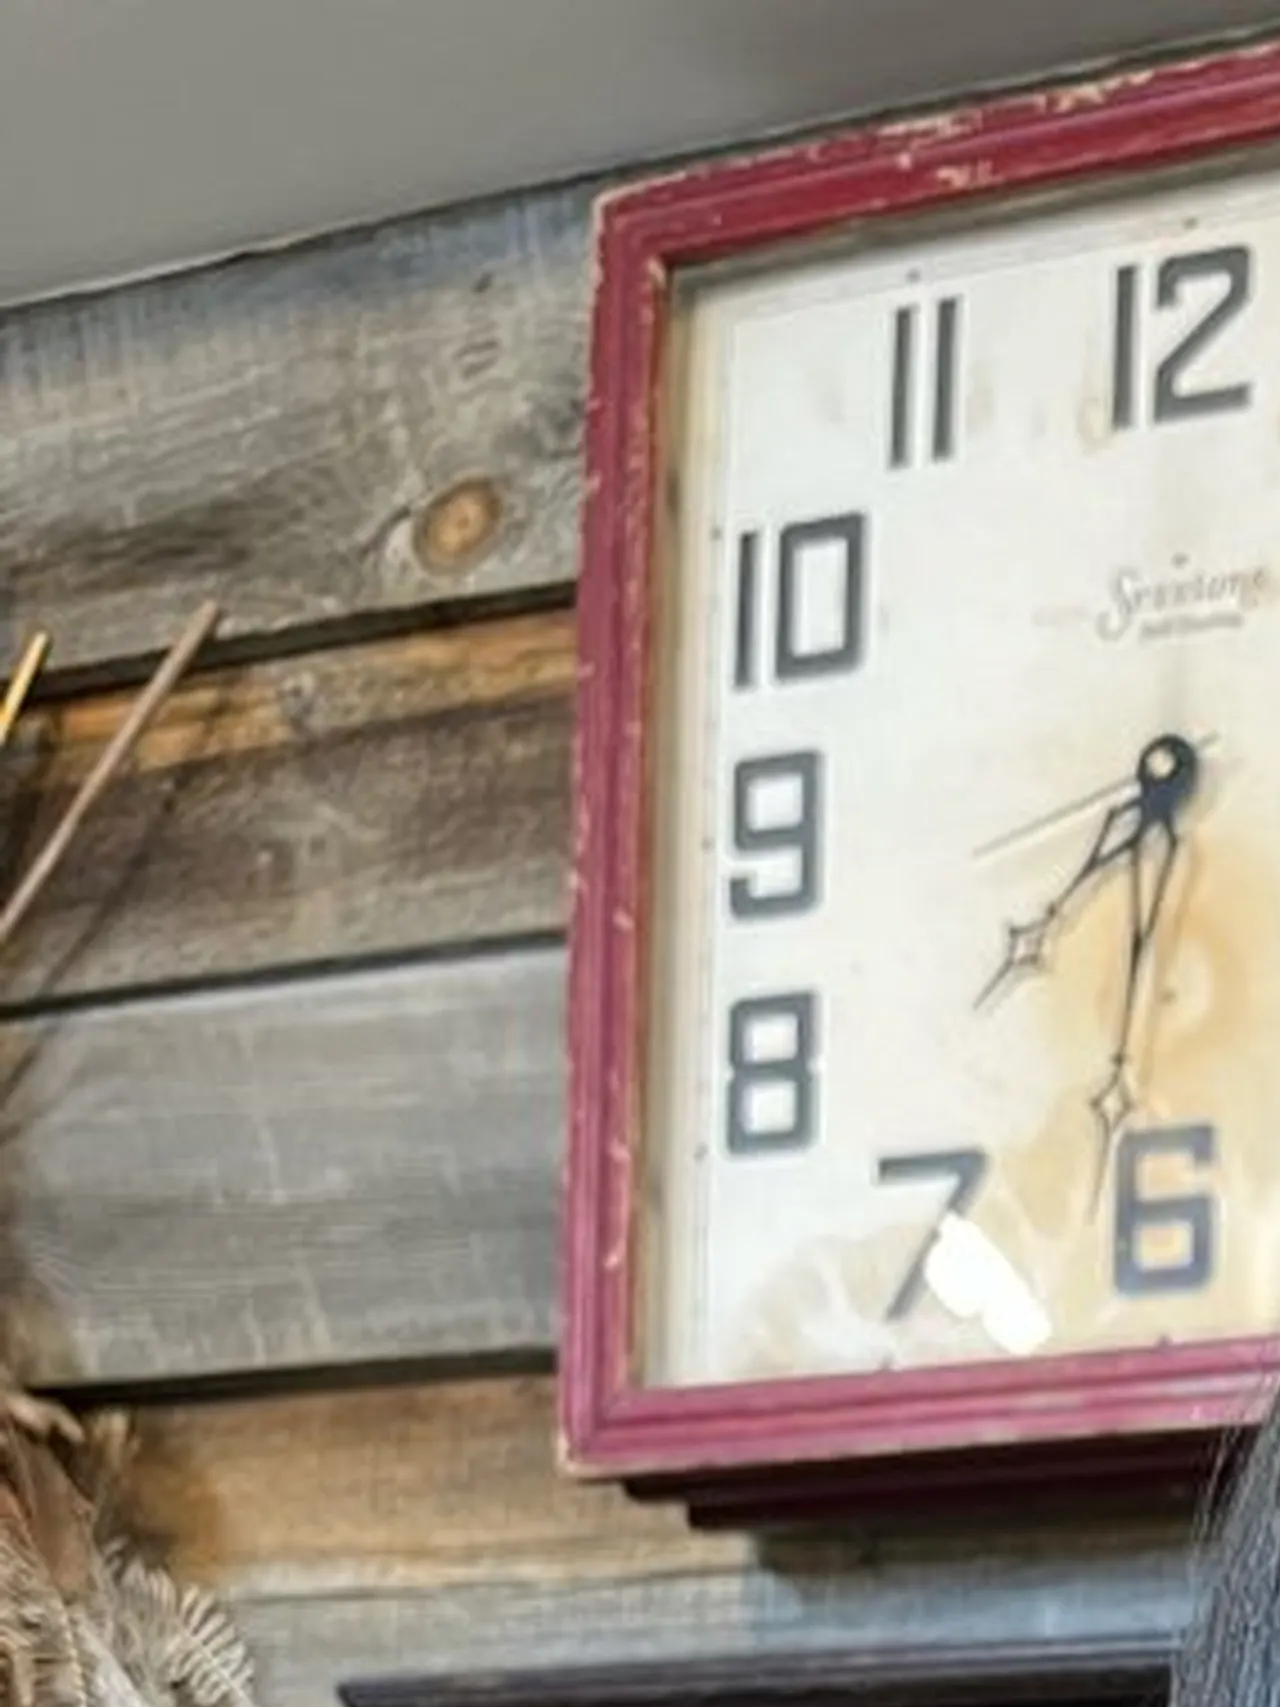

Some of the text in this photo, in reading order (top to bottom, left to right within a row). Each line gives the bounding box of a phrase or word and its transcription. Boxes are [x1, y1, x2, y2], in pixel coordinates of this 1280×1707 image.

[888, 296, 960, 470] 11
[1110, 244, 1252, 432] 12
[732, 511, 868, 693] 10
[728, 749, 823, 921] 9
[725, 990, 818, 1156] 8
[877, 1148, 988, 1320] 7
[1114, 1124, 1214, 1294] 6
